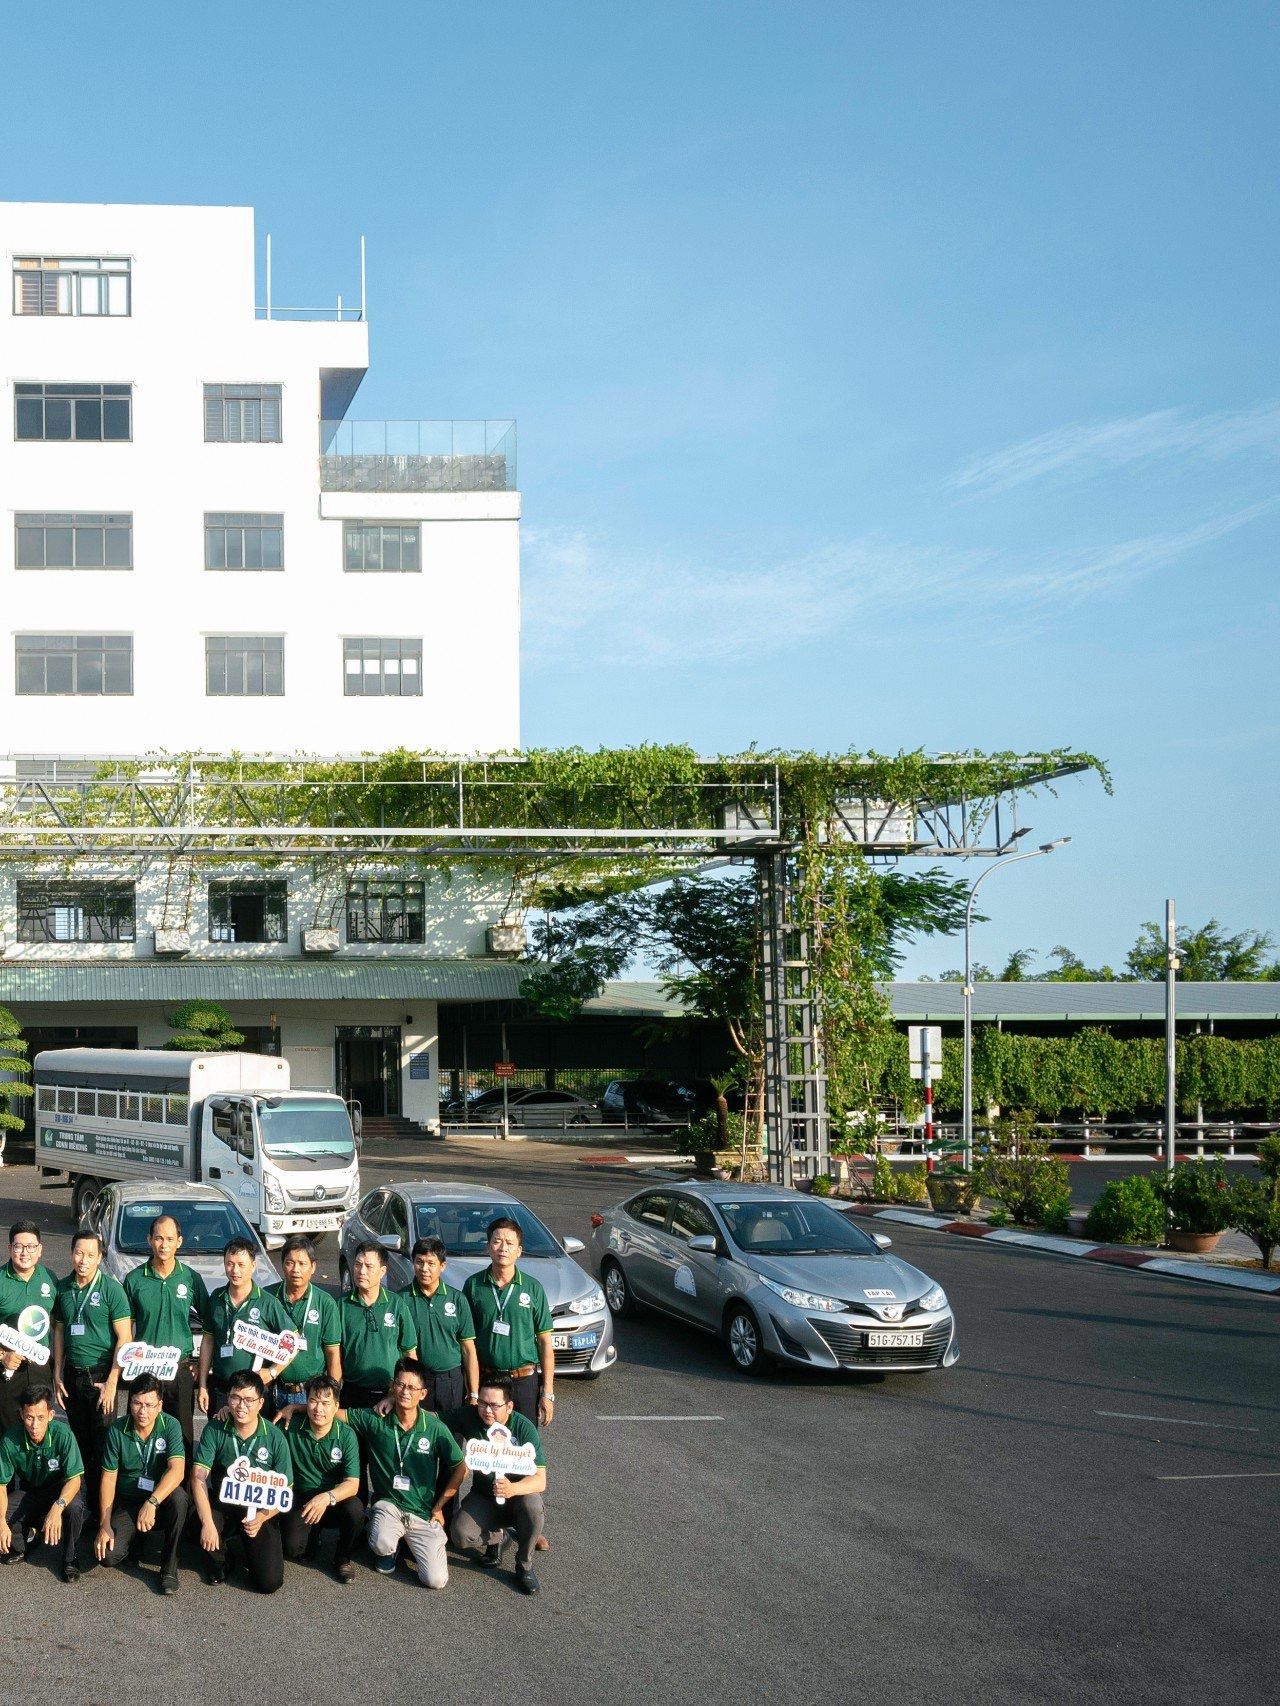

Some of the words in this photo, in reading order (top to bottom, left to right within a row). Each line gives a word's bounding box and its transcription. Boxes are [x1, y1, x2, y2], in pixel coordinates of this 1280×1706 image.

[0, 1330, 45, 1361] MEKONG
[870, 1334, 921, 1346] 51G-757.15
[224, 1481, 240, 1500] A1
[244, 1484, 263, 1504] A2
[266, 1488, 277, 1506] B
[280, 1490, 290, 1508] C
